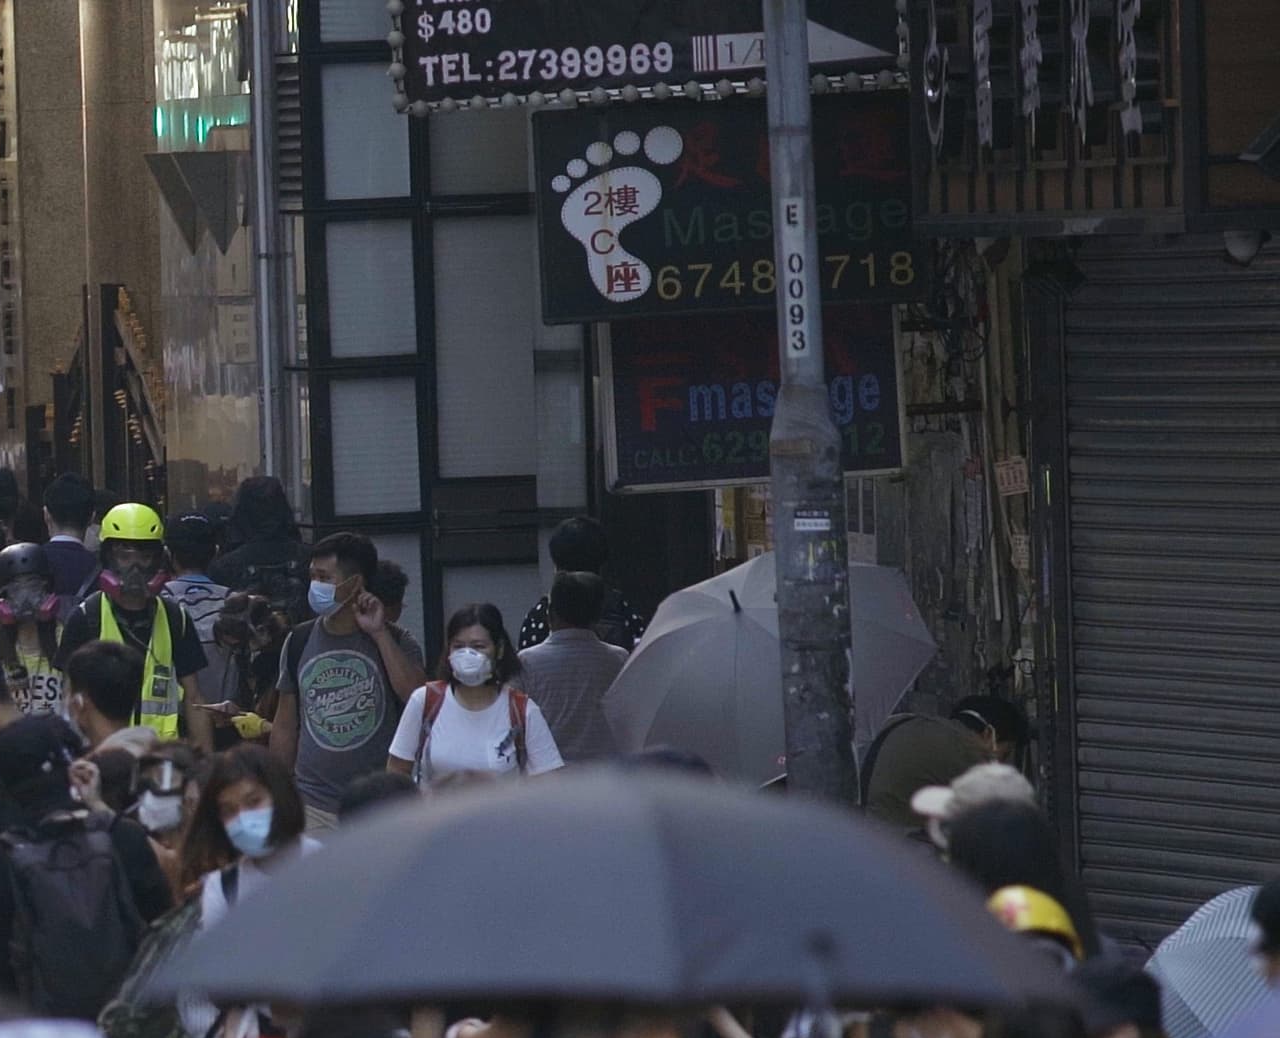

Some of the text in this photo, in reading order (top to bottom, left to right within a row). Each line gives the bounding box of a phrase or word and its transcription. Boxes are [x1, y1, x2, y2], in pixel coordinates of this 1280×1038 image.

[417, 8, 492, 42] $480
[418, 41, 674, 86] TEL:27399969
[583, 184, 640, 217] 2樓
[590, 228, 615, 255] C
[663, 199, 909, 248] Masage
[606, 261, 642, 295] 座
[656, 251, 916, 301] 6748718
[786, 204, 806, 351] E 0093
[641, 373, 881, 433] F masge
[316, 668, 357, 683] QUALITY
